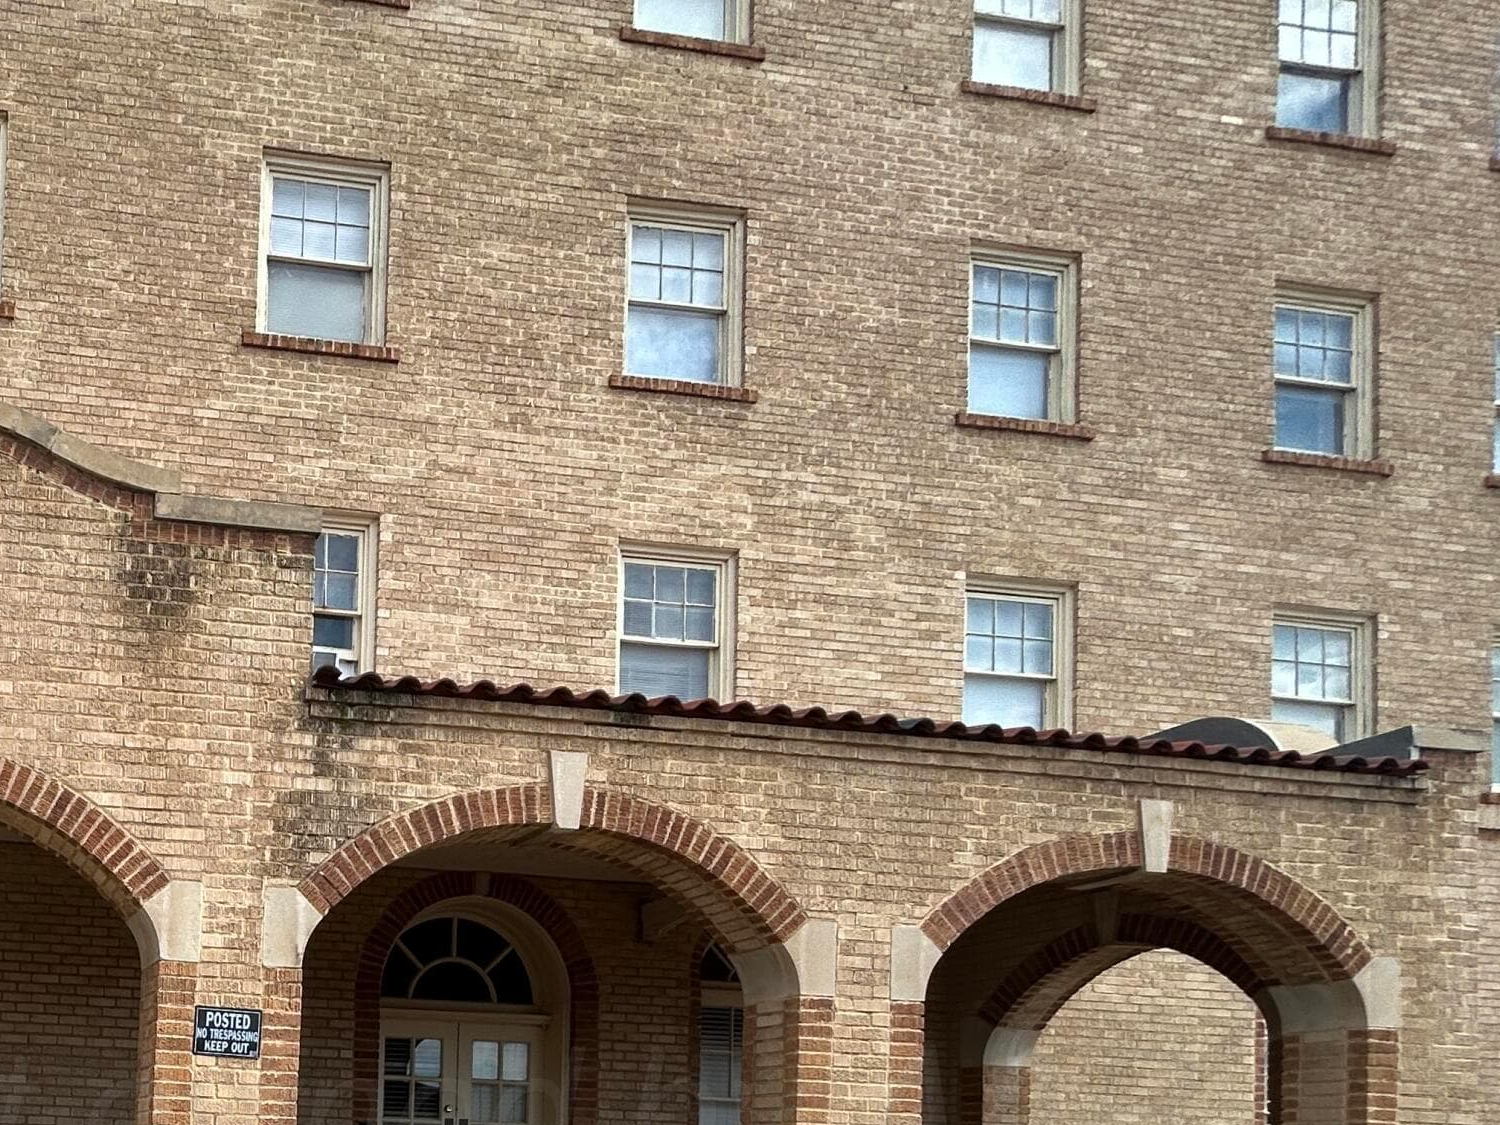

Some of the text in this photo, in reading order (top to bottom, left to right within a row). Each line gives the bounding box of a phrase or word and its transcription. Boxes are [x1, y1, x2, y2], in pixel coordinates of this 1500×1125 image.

[205, 1011, 251, 1030] POSTED
[196, 1027, 259, 1042] NO TRESPASSING
[204, 1040, 229, 1052] KEEP
[231, 1042, 250, 1054] OUT
